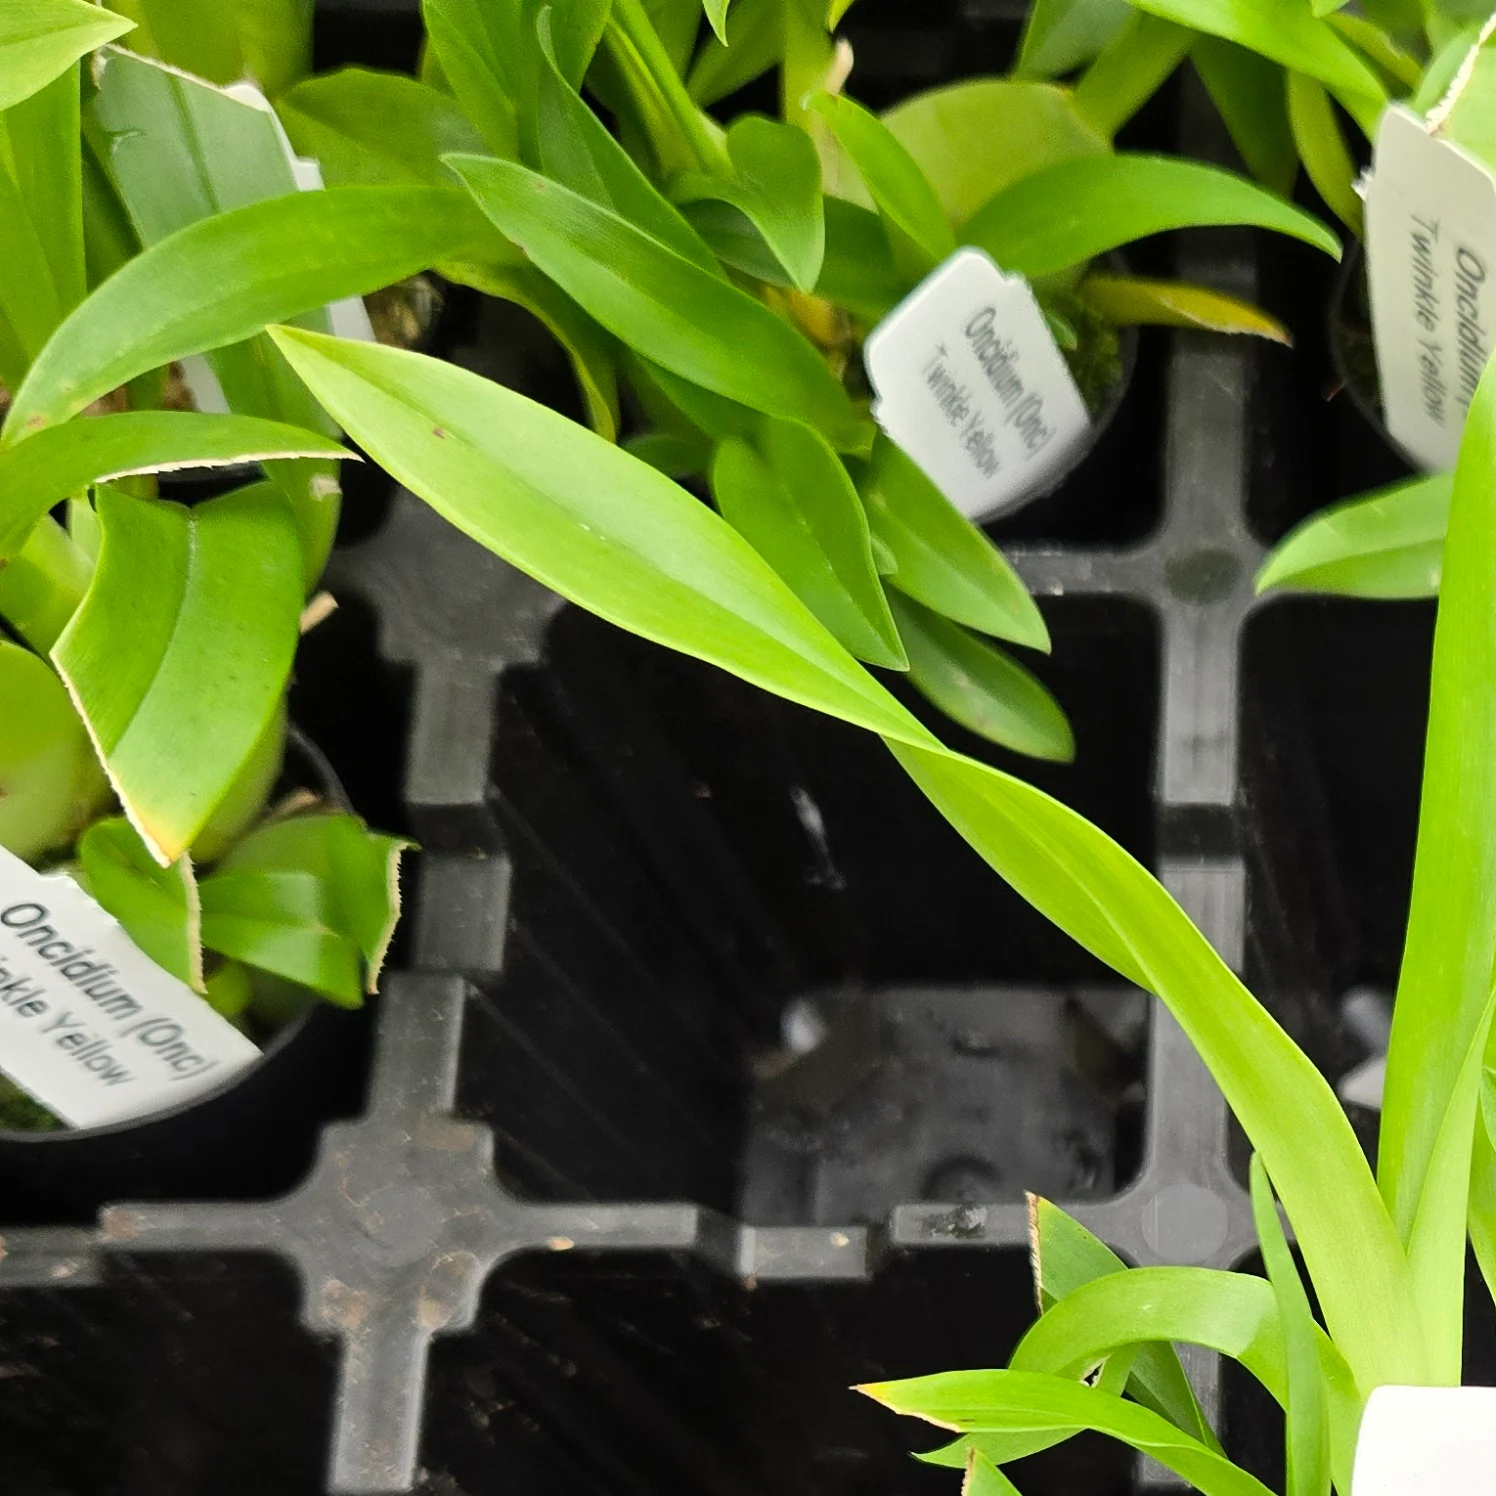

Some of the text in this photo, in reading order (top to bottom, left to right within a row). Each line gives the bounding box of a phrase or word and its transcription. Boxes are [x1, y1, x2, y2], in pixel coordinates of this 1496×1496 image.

[1410, 213, 1447, 429] Twinkle Yellow
[0, 903, 220, 1082] Oncidium (Onc)
[41, 1010, 137, 1086] Yellow
